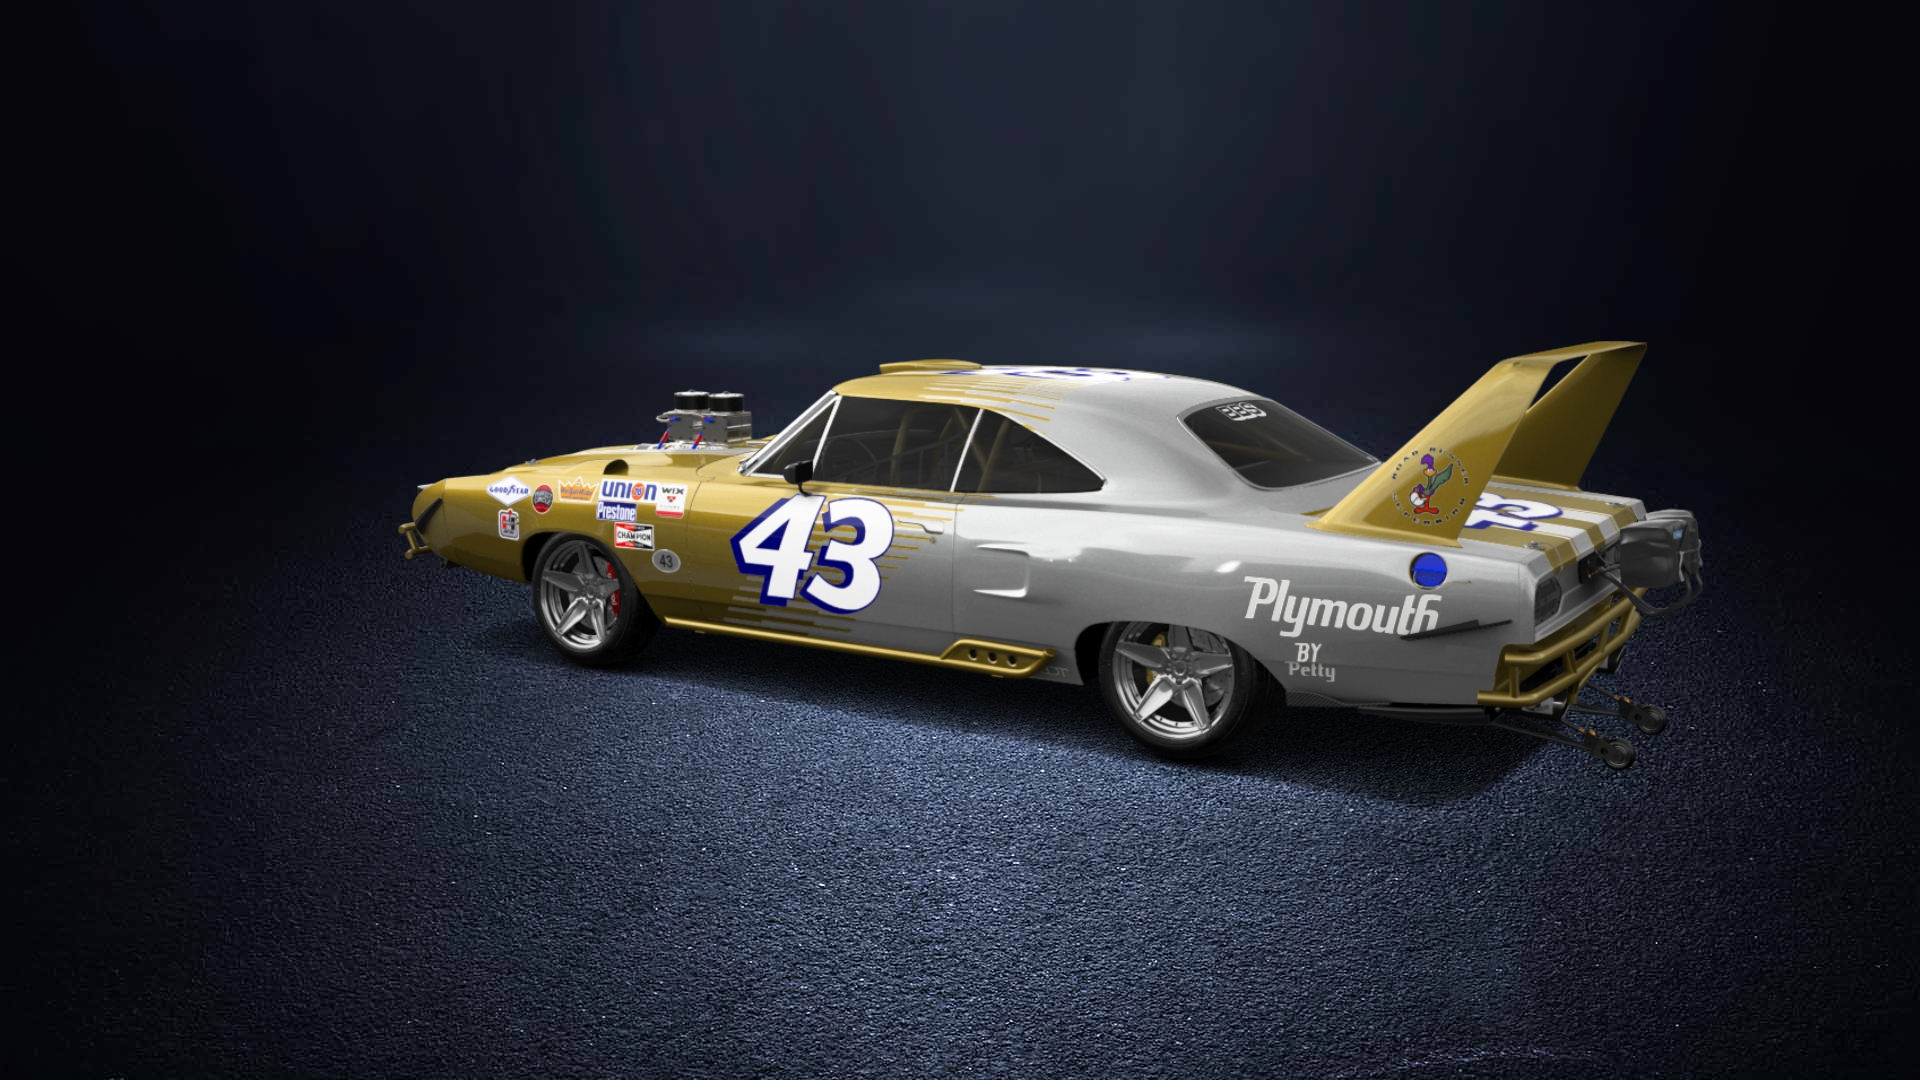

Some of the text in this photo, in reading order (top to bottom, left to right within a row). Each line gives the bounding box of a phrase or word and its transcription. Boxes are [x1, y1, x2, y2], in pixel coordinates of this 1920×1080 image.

[489, 485, 529, 496] GOODYEAR
[601, 481, 658, 502] UNION
[662, 487, 685, 495] WIX
[597, 501, 636, 522] Prestone
[617, 530, 651, 541] CHAMPION
[659, 554, 674, 568] 43
[730, 493, 895, 615] 43
[1244, 576, 1442, 638] Plymouth
[1294, 642, 1322, 663] BY
[1285, 660, 1336, 682] Petty
